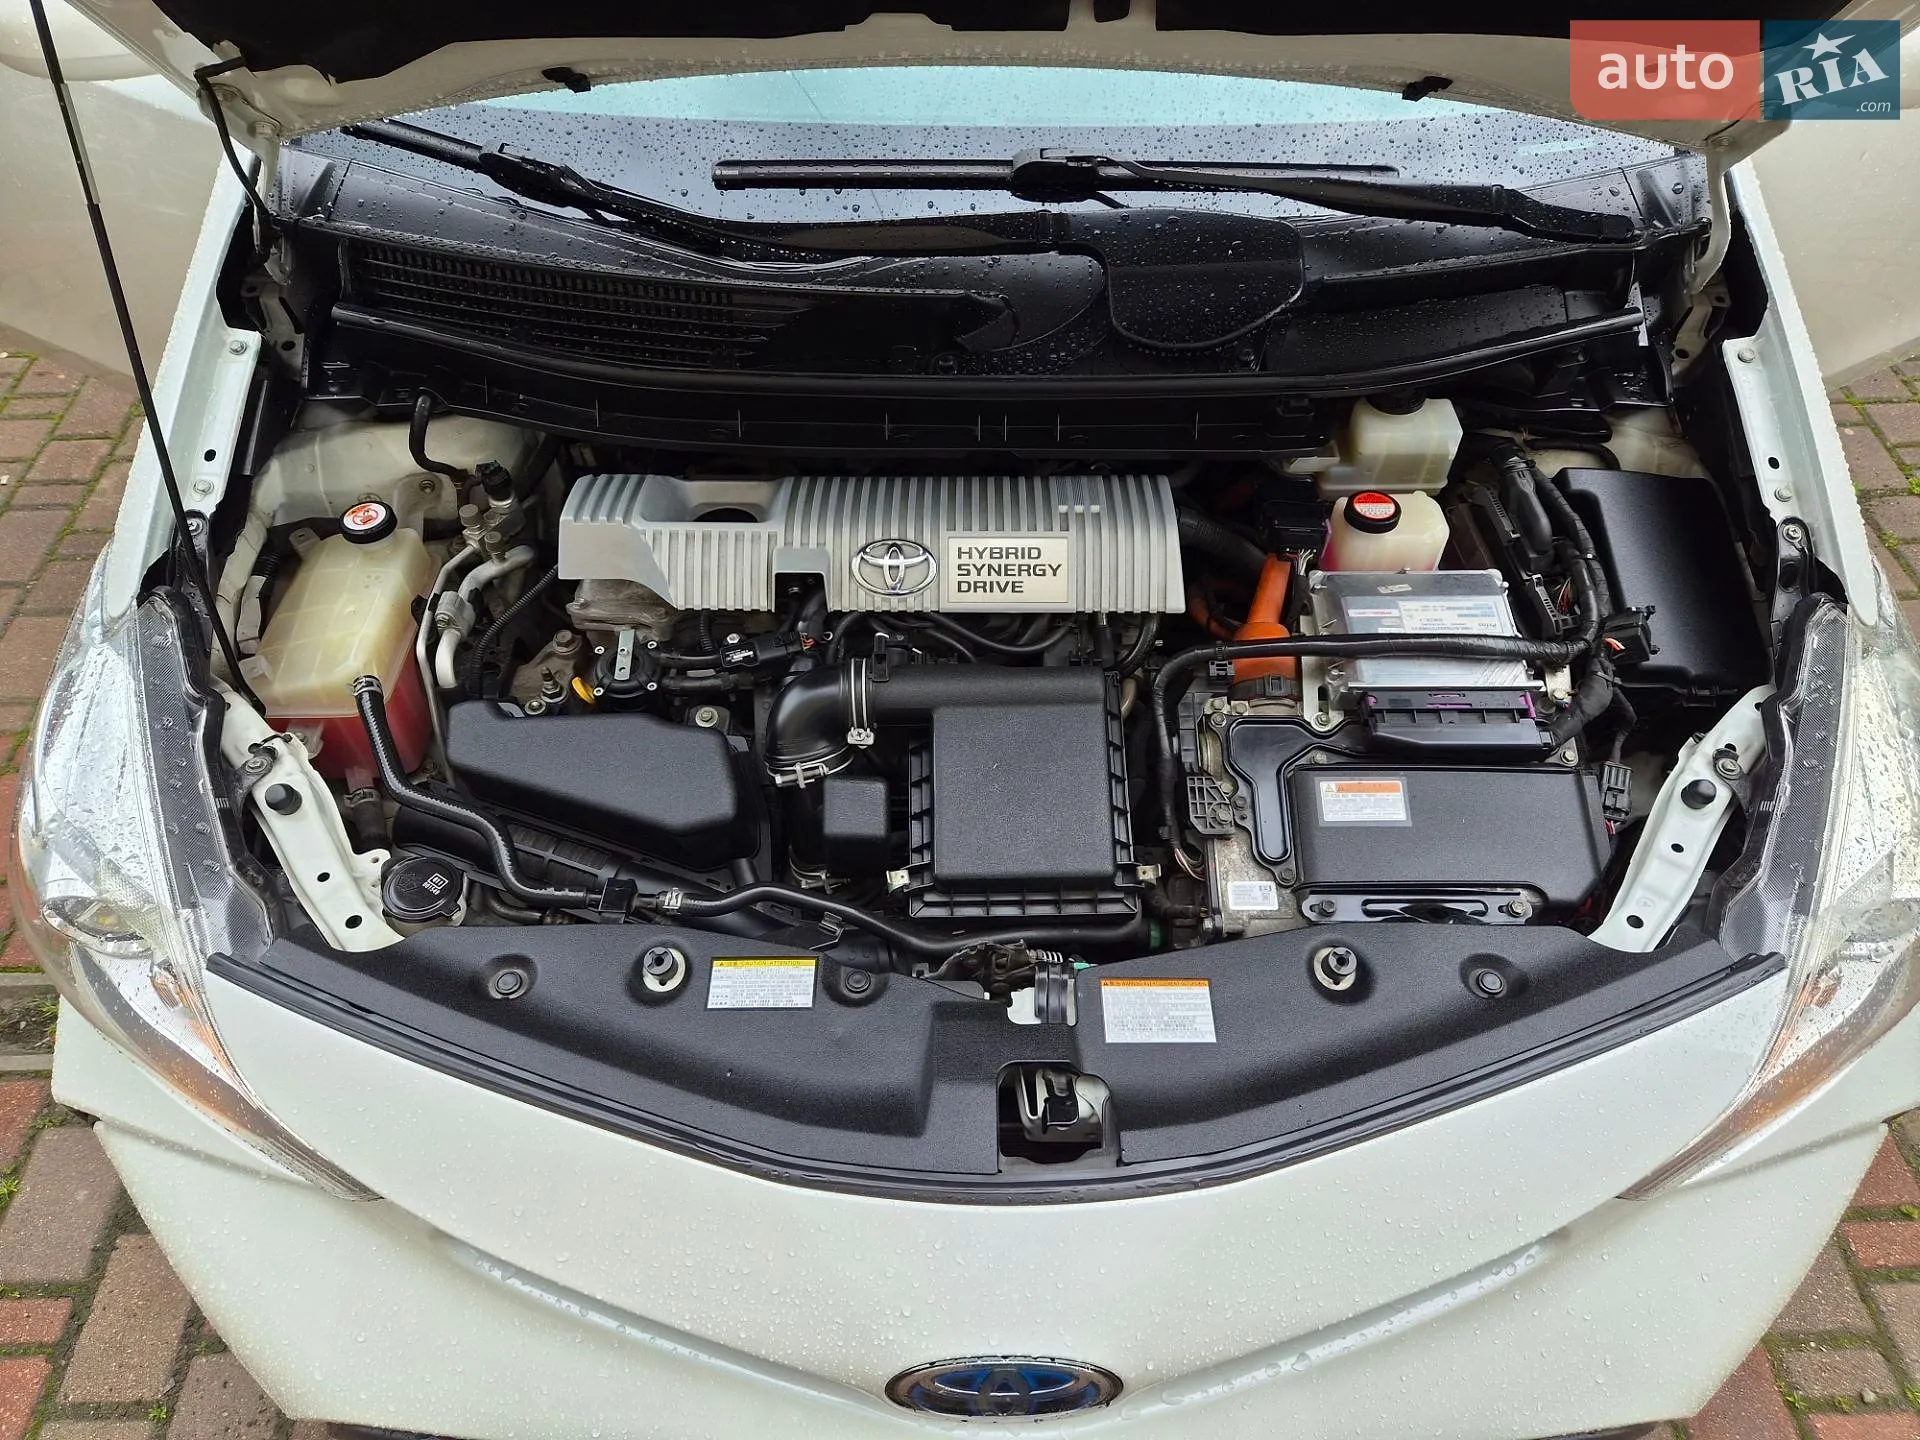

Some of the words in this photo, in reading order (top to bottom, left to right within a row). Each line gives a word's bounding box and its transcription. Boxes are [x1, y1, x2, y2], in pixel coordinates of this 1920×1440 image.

[957, 546, 1042, 560] HYBRID
[957, 563, 1063, 577] SYNERGY
[957, 580, 1024, 594] DRIVE
